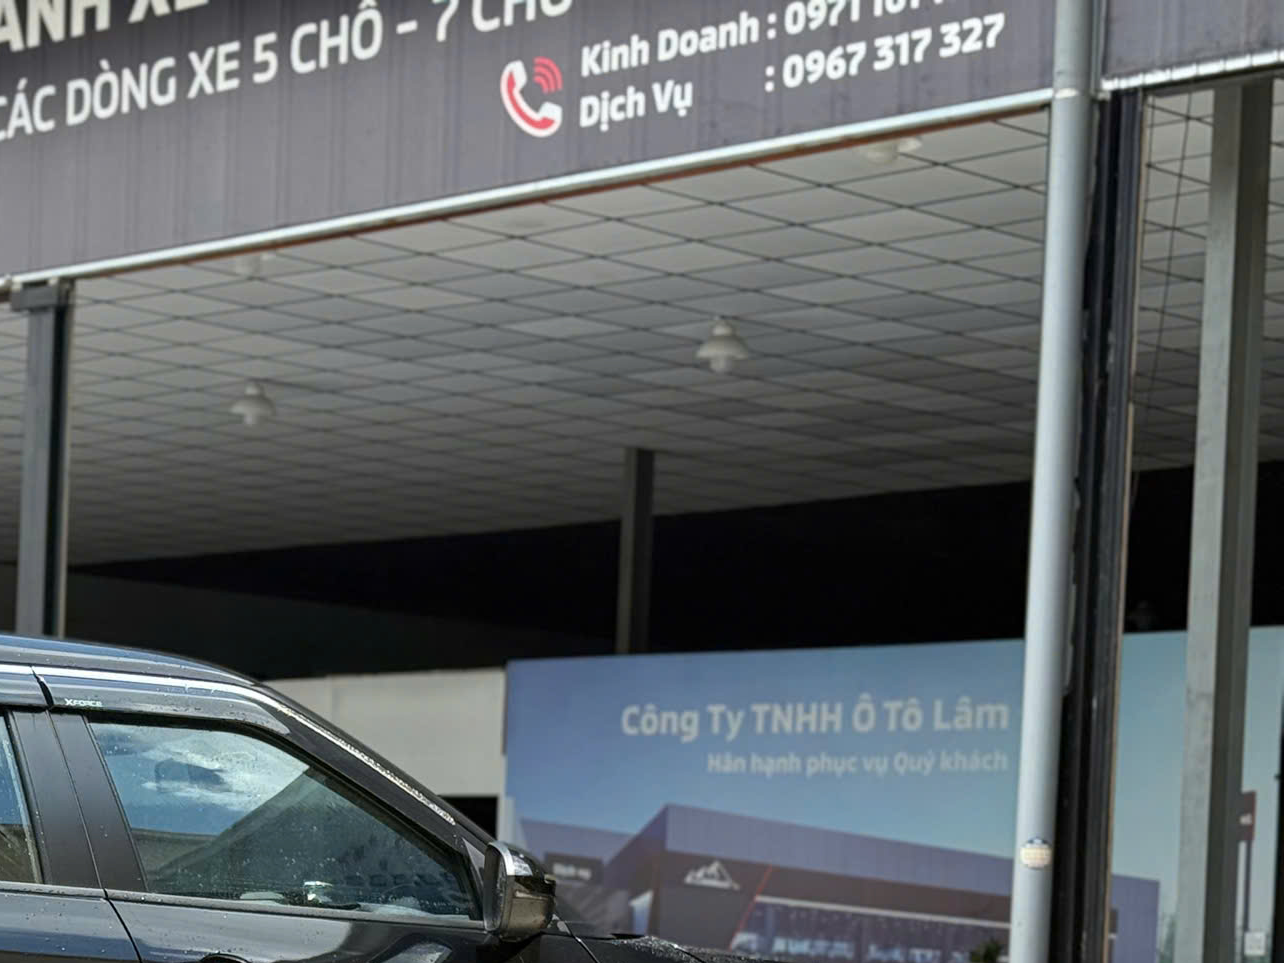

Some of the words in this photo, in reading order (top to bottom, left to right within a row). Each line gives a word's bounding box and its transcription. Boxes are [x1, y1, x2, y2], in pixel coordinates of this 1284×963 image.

[66, 59, 176, 126] DÒNG
[187, 41, 241, 99] XE
[253, 32, 278, 83] 5
[428, 0, 459, 42] 7
[580, 85, 646, 132] Dịch
[652, 79, 693, 117] Vụ
[782, 41, 867, 88] 0967
[873, 28, 932, 72] 317
[939, 13, 1005, 58] 327
[581, 34, 649, 77] Kinh
[658, 11, 760, 62] Doanh
[621, 703, 701, 744] Công
[706, 703, 745, 742] Ty
[751, 701, 843, 735] TNHH
[852, 691, 877, 733] Ô
[884, 697, 924, 733] Tô
[933, 695, 1011, 732] Lâm
